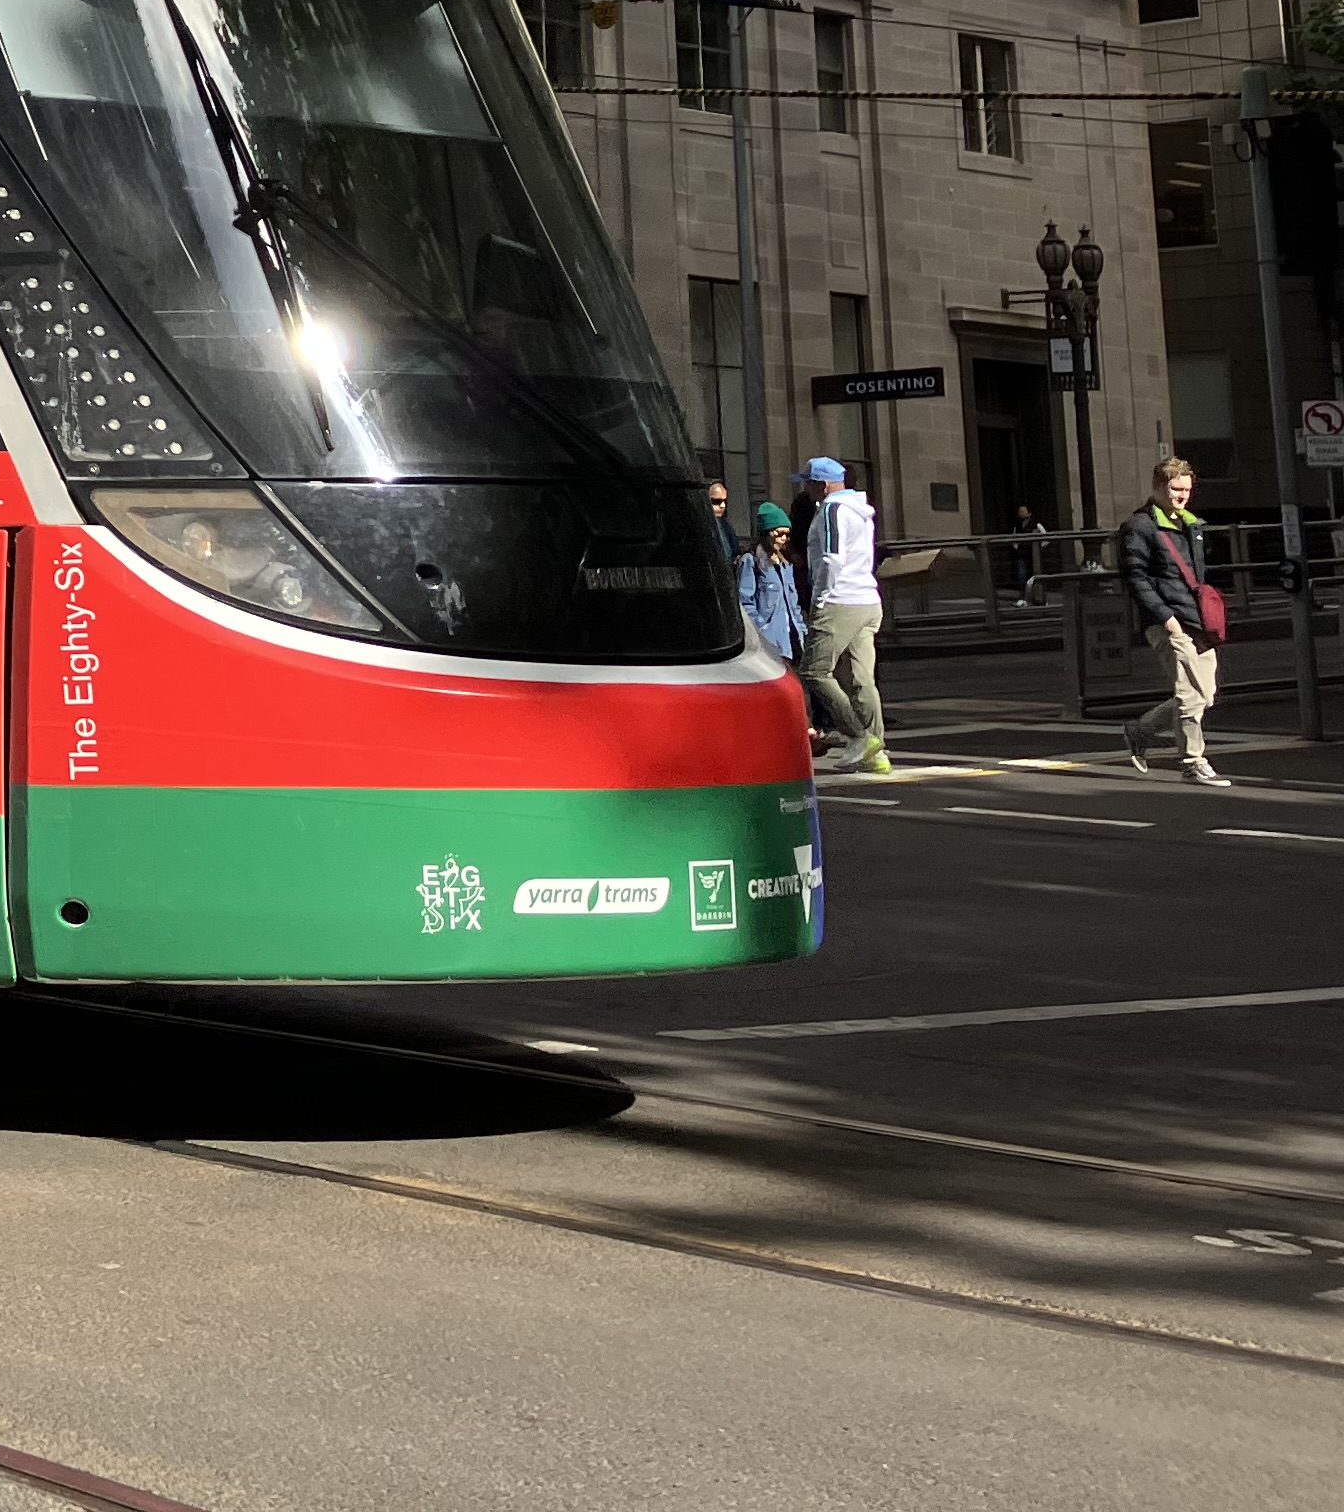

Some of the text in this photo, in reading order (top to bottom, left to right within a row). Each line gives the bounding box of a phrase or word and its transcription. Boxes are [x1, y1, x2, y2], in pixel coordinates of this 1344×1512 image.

[845, 375, 936, 395] COSENTINO
[54, 541, 101, 781] The Eighty-Six
[528, 885, 658, 908] yarra trams
[747, 874, 801, 900] CREATIVE
[696, 911, 732, 921] DAREBIN
